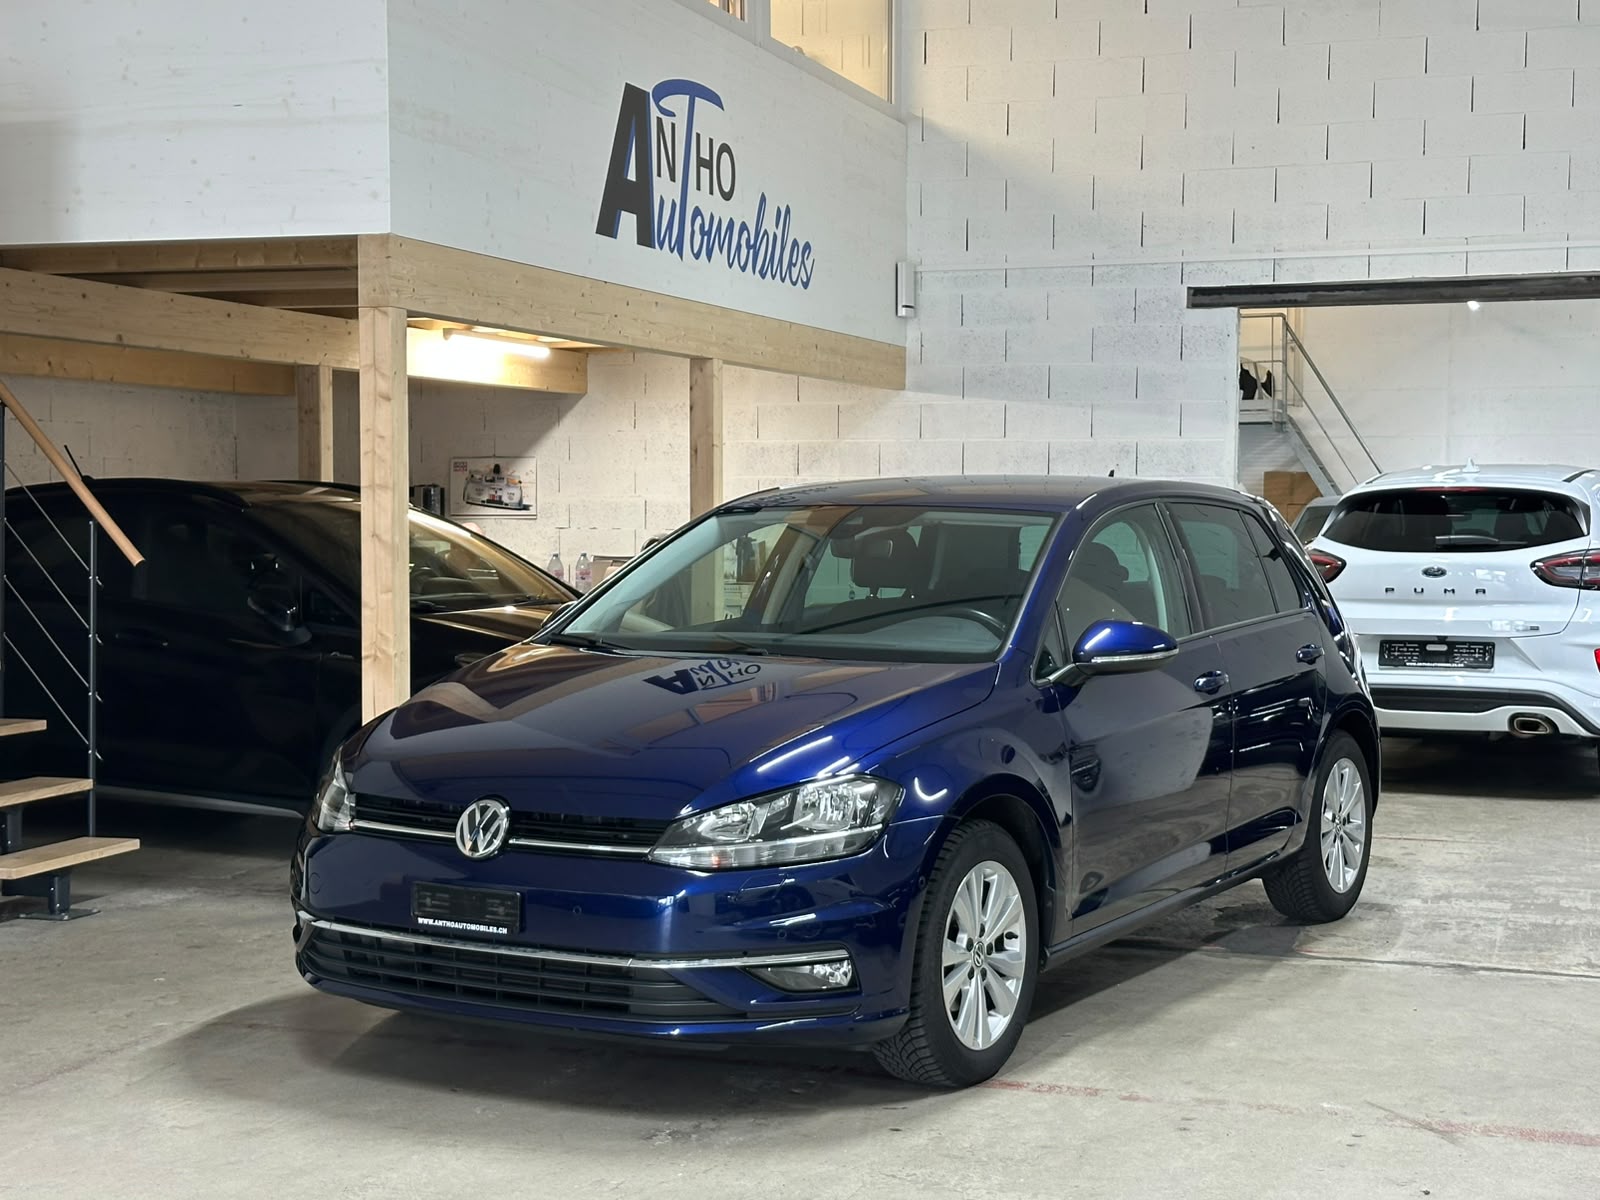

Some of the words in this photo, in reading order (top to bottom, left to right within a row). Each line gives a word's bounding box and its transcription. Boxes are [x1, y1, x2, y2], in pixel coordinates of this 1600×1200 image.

[596, 79, 736, 261] ANTHO
[1384, 587, 1487, 595] PUMA
[417, 917, 508, 935] WWW.ANTHOAUTOMOBILES.CH
